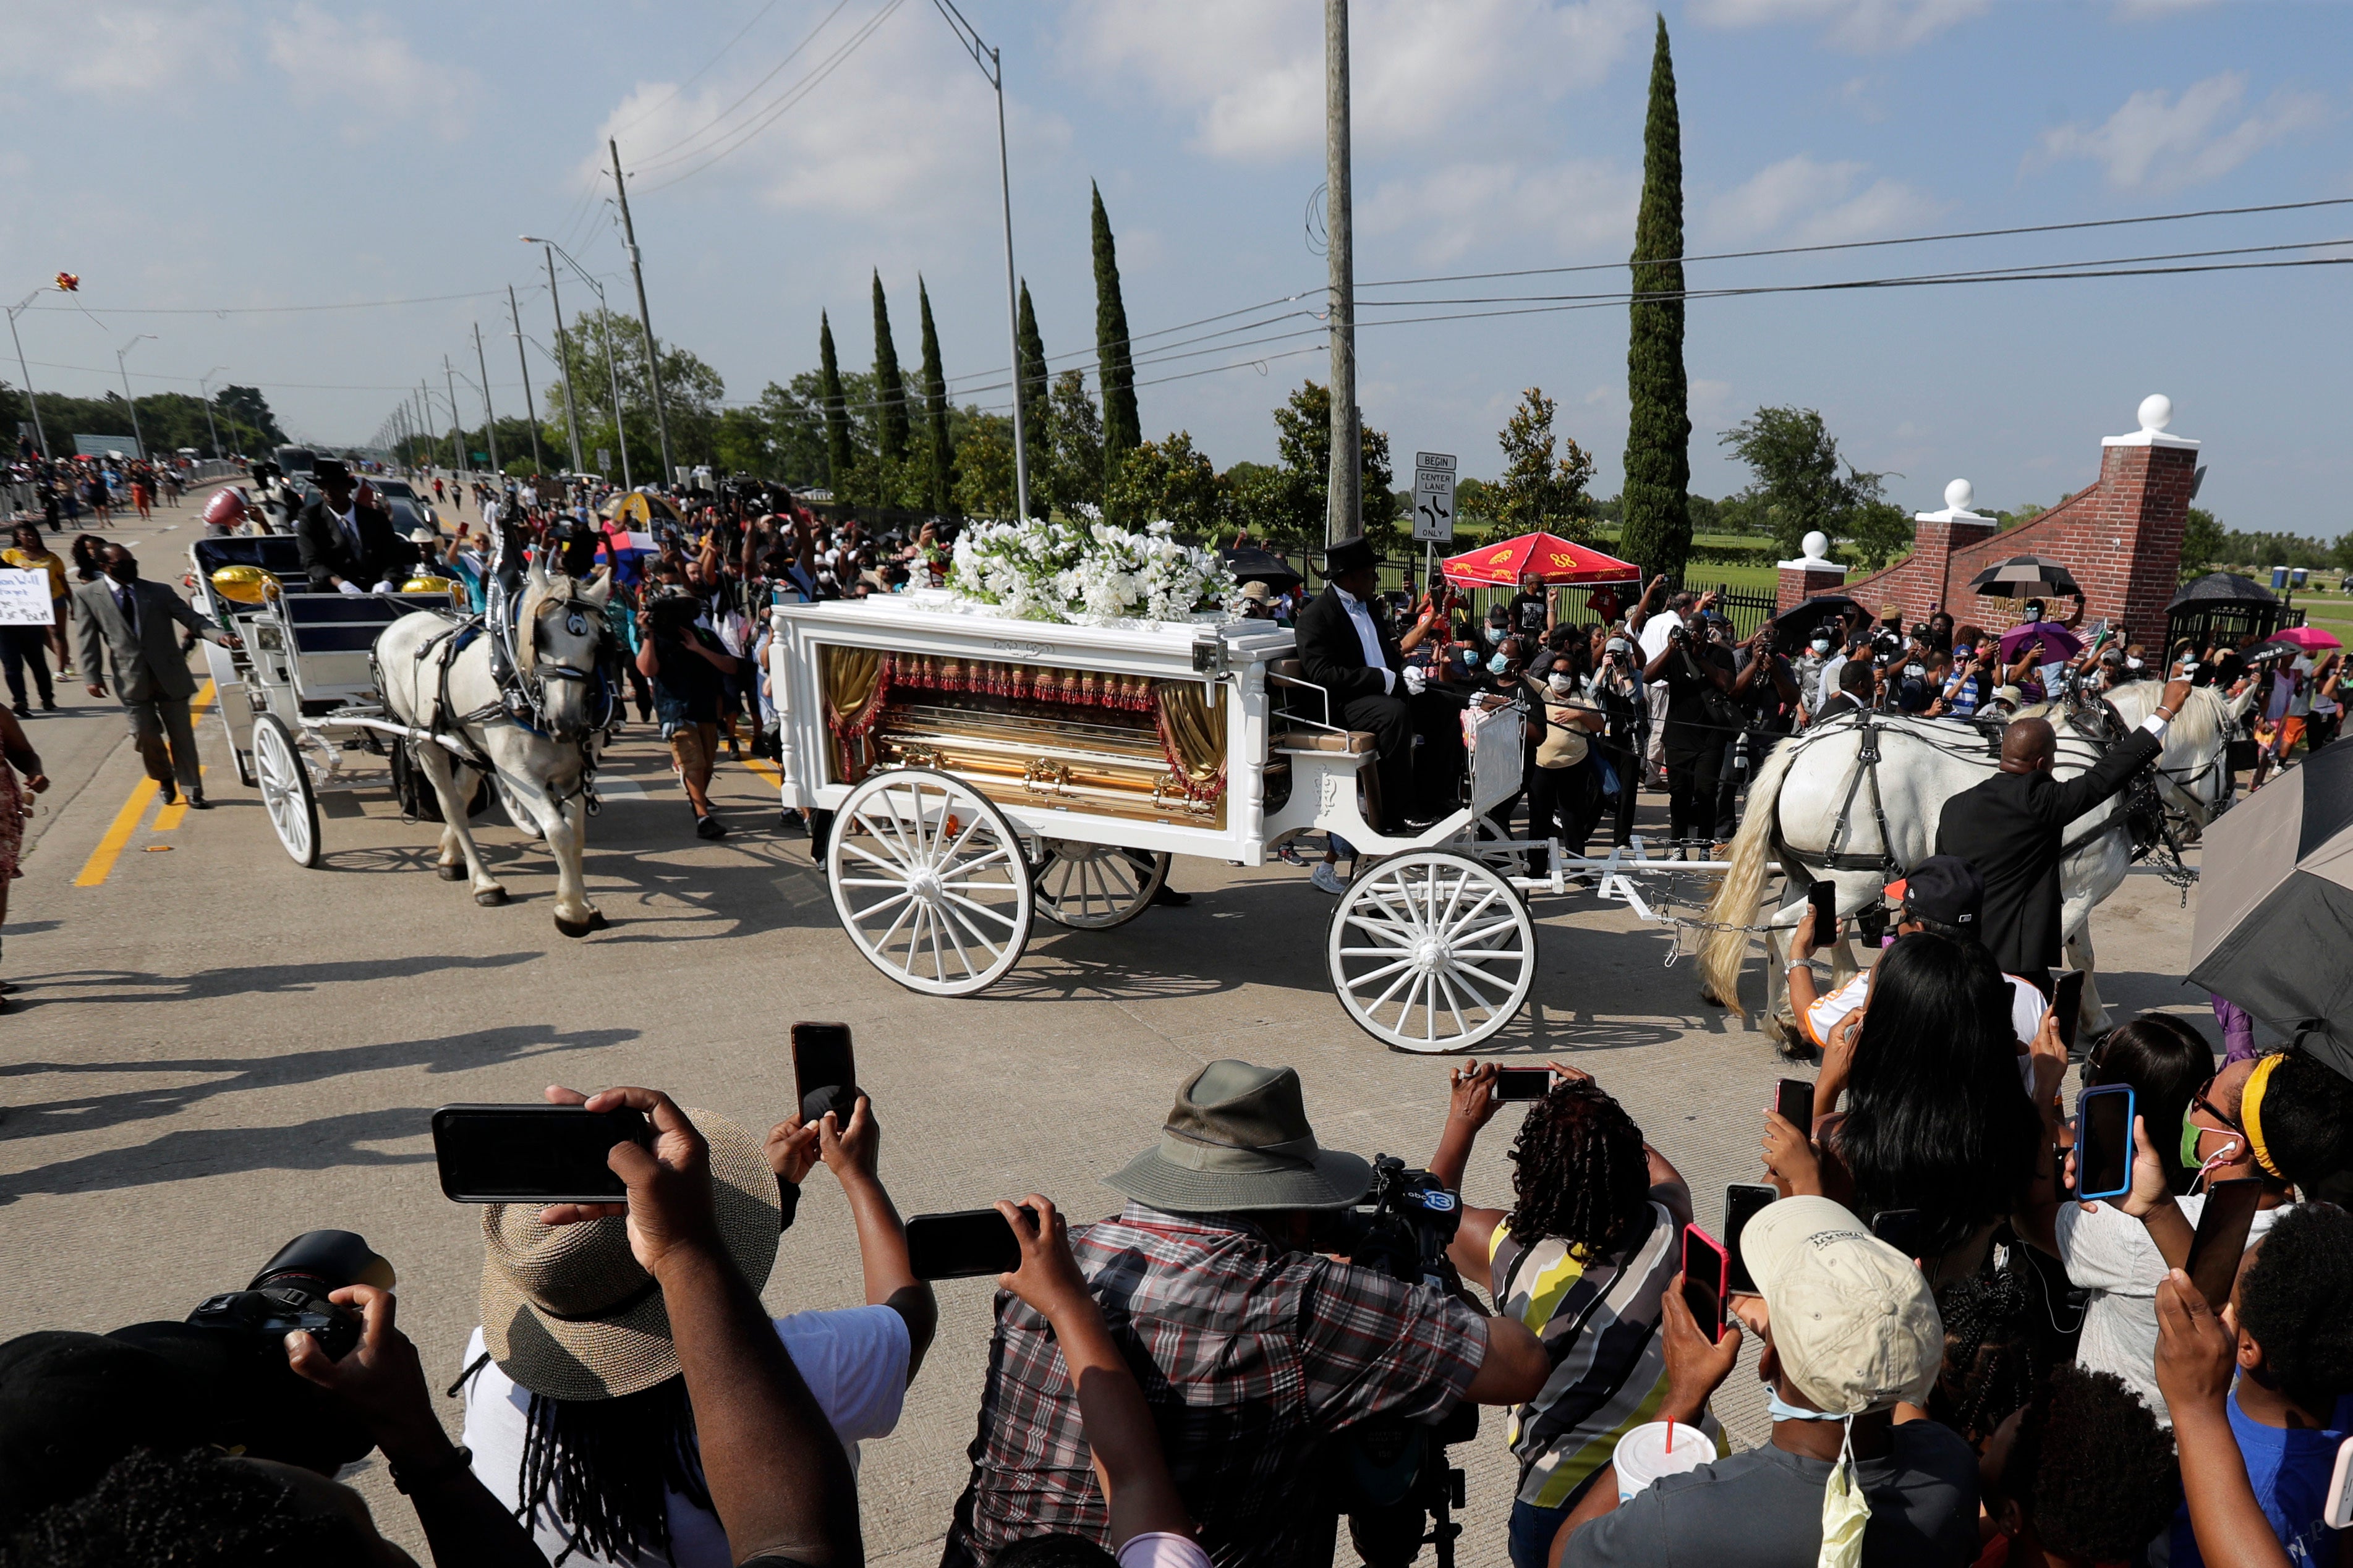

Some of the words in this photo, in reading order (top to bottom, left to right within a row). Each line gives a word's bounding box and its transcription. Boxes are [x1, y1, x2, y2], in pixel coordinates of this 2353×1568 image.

[1424, 456, 1448, 467] BEGIN
[1421, 473, 1450, 482] CENTER
[1424, 483, 1445, 491] LANE
[1423, 529, 1444, 537] ONLY
[1549, 553, 1577, 568] 88
[1408, 1192, 1427, 1200] abc
[1428, 1195, 1451, 1207] 13
